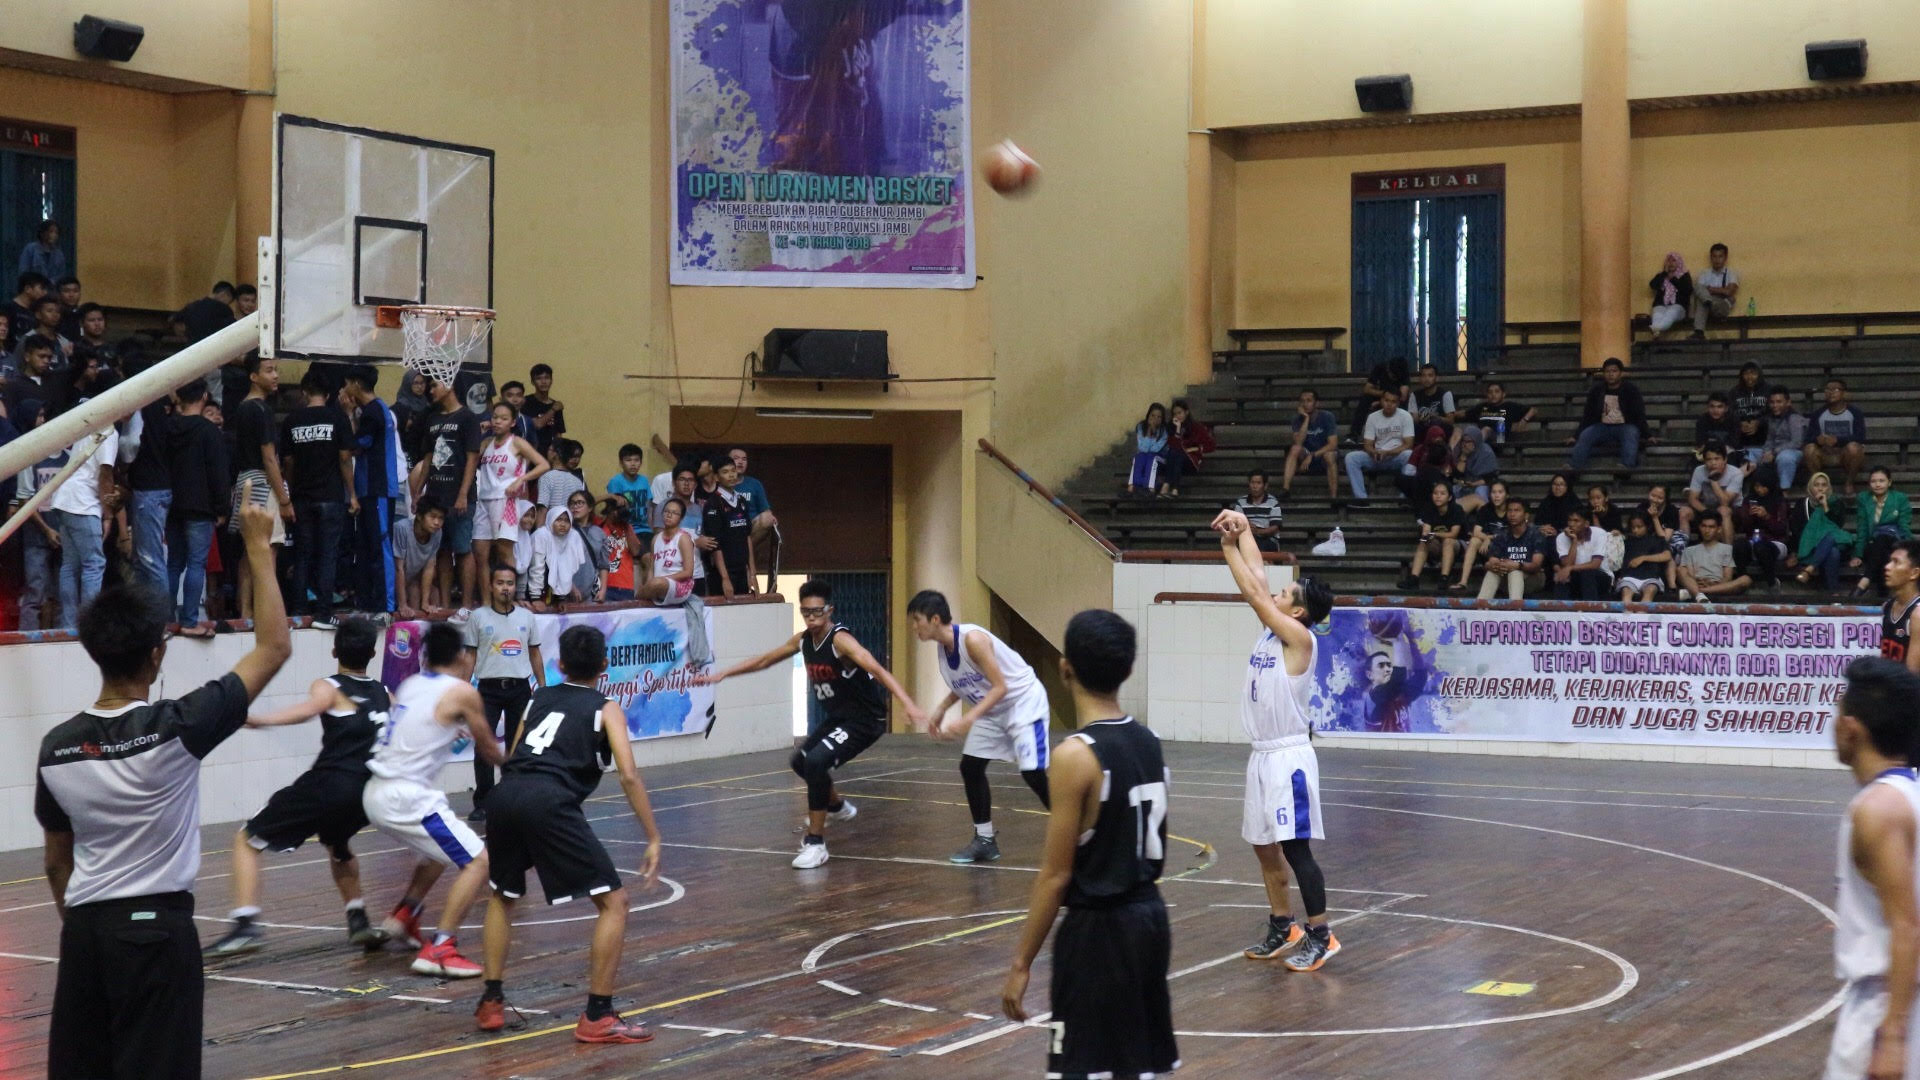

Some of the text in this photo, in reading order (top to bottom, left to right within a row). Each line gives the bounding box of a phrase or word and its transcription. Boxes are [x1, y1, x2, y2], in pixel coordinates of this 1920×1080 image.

[5, 127, 49, 145] UAR
[688, 172, 954, 206] OPEN TURNAMEN BASKET
[1380, 173, 1478, 190] KELUAR
[717, 204, 926, 220] MEMPEREBUTKAN PIALA GUBERNUR JAMBI
[733, 220, 911, 235] DALAM RANGKA HUT PROVINSI JAMBI
[775, 236, 788, 249] KE
[809, 236, 844, 250] TAHUN
[846, 236, 871, 250] 2018
[1460, 621, 1883, 649] LAPANGAN BASKET CUMA PERSEGI PAN
[610, 641, 676, 667] BERTANDING
[1531, 651, 1860, 678] TETAPI DIDALAMNYA ADA BANYA
[599, 673, 639, 707] Tinggi
[814, 682, 835, 701] 28
[1441, 677, 1847, 706] KERJASAMA, KERJAKERAS, SEMANGAT KE
[1572, 706, 1831, 734] DAN JUGA SAHABAT
[525, 711, 565, 755] 4
[828, 727, 849, 745] 28
[1276, 807, 1288, 826] 6
